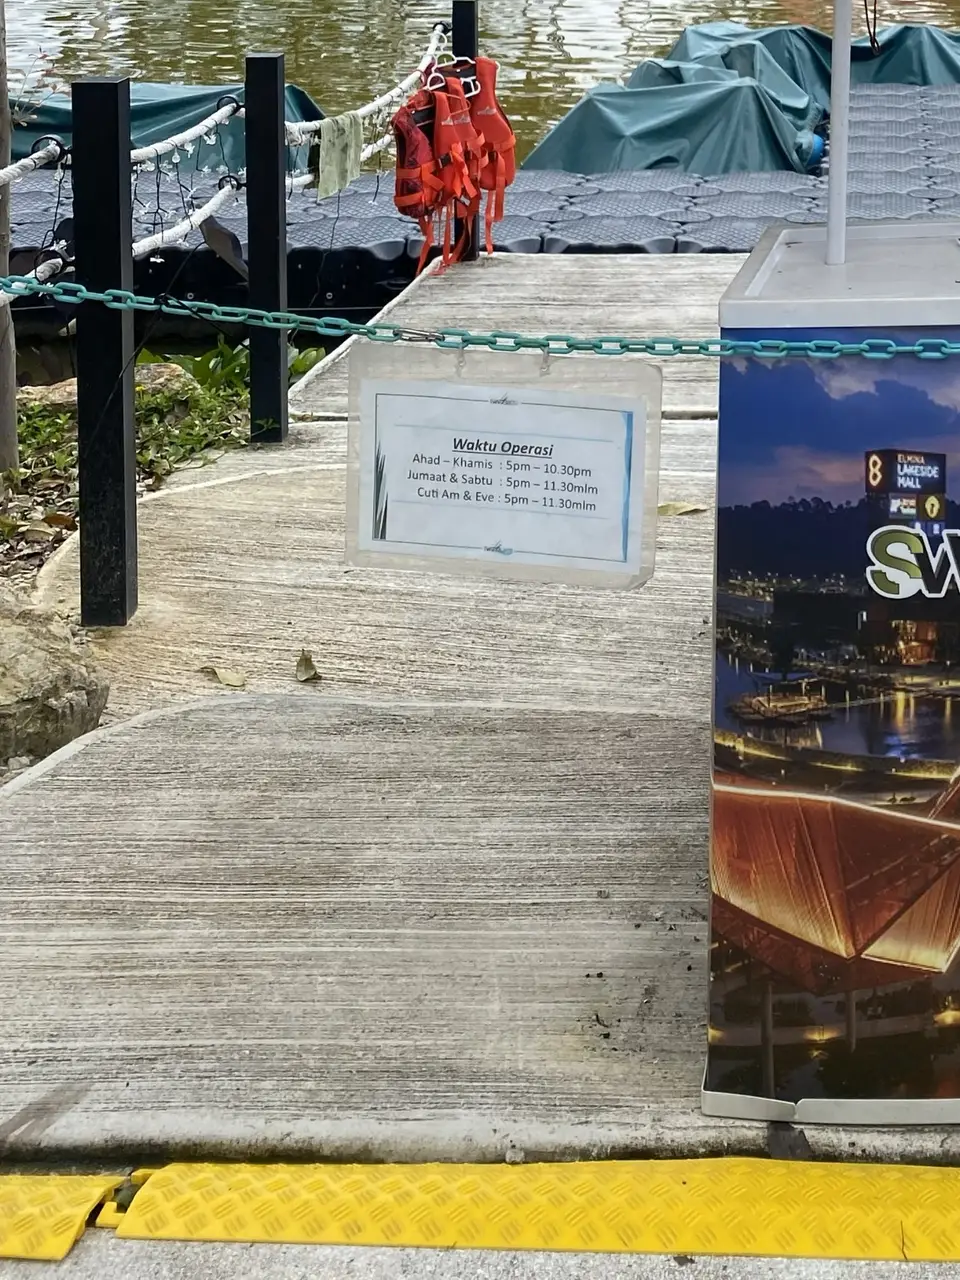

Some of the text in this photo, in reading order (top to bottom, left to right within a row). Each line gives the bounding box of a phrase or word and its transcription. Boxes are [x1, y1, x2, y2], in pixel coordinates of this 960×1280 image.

[452, 438, 553, 458] Waktu Operasi
[412, 453, 440, 466] Ahad
[453, 457, 493, 470] Khamis
[506, 460, 531, 474] 5pm
[543, 464, 592, 478] 10.30pm
[897, 454, 925, 464] ELMINA
[897, 463, 939, 478] LAKESIDE
[407, 470, 446, 483] Jumaat
[449, 473, 458, 484] &
[461, 474, 493, 486] Sabtu
[506, 477, 531, 491] 5pm
[543, 481, 598, 495] 11.30mlm
[897, 476, 922, 489] MALL
[417, 487, 439, 499] Cuti
[441, 489, 460, 501] Am
[463, 491, 472, 501] &
[475, 492, 495, 503] Eve
[504, 494, 529, 507] 5pm
[542, 497, 596, 511] 11.30mlm
